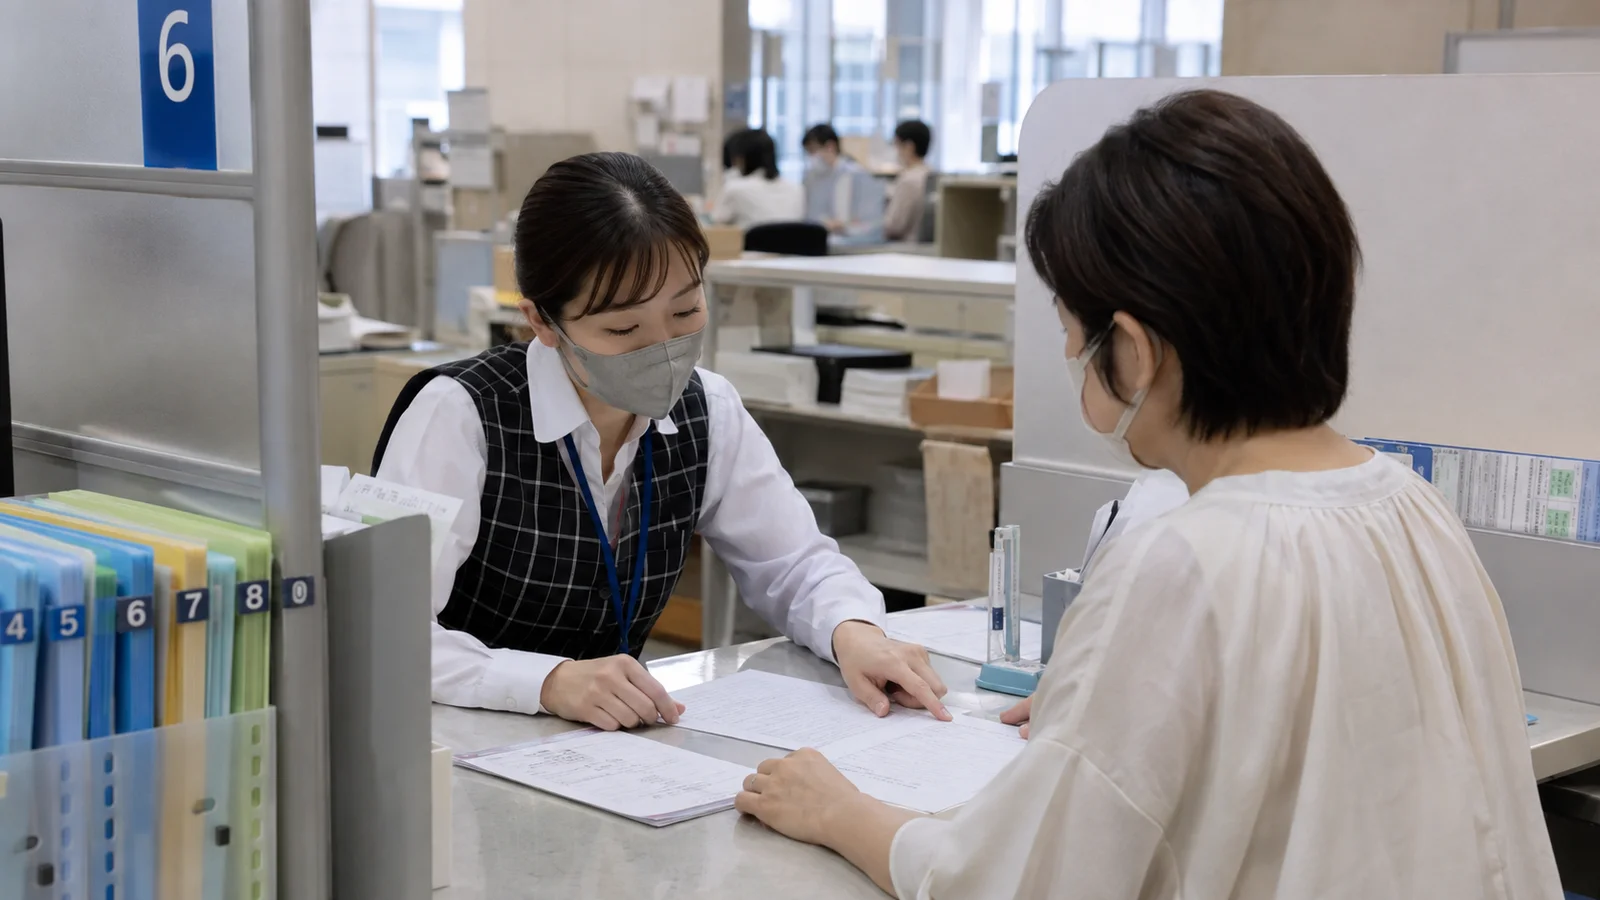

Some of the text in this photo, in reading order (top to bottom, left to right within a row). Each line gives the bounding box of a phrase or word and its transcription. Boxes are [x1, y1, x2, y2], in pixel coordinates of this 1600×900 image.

[158, 9, 195, 103] 6
[184, 592, 203, 619] 7
[245, 584, 264, 610] 8
[5, 612, 27, 640] 4
[60, 608, 79, 637] 5
[127, 599, 146, 627] 6
